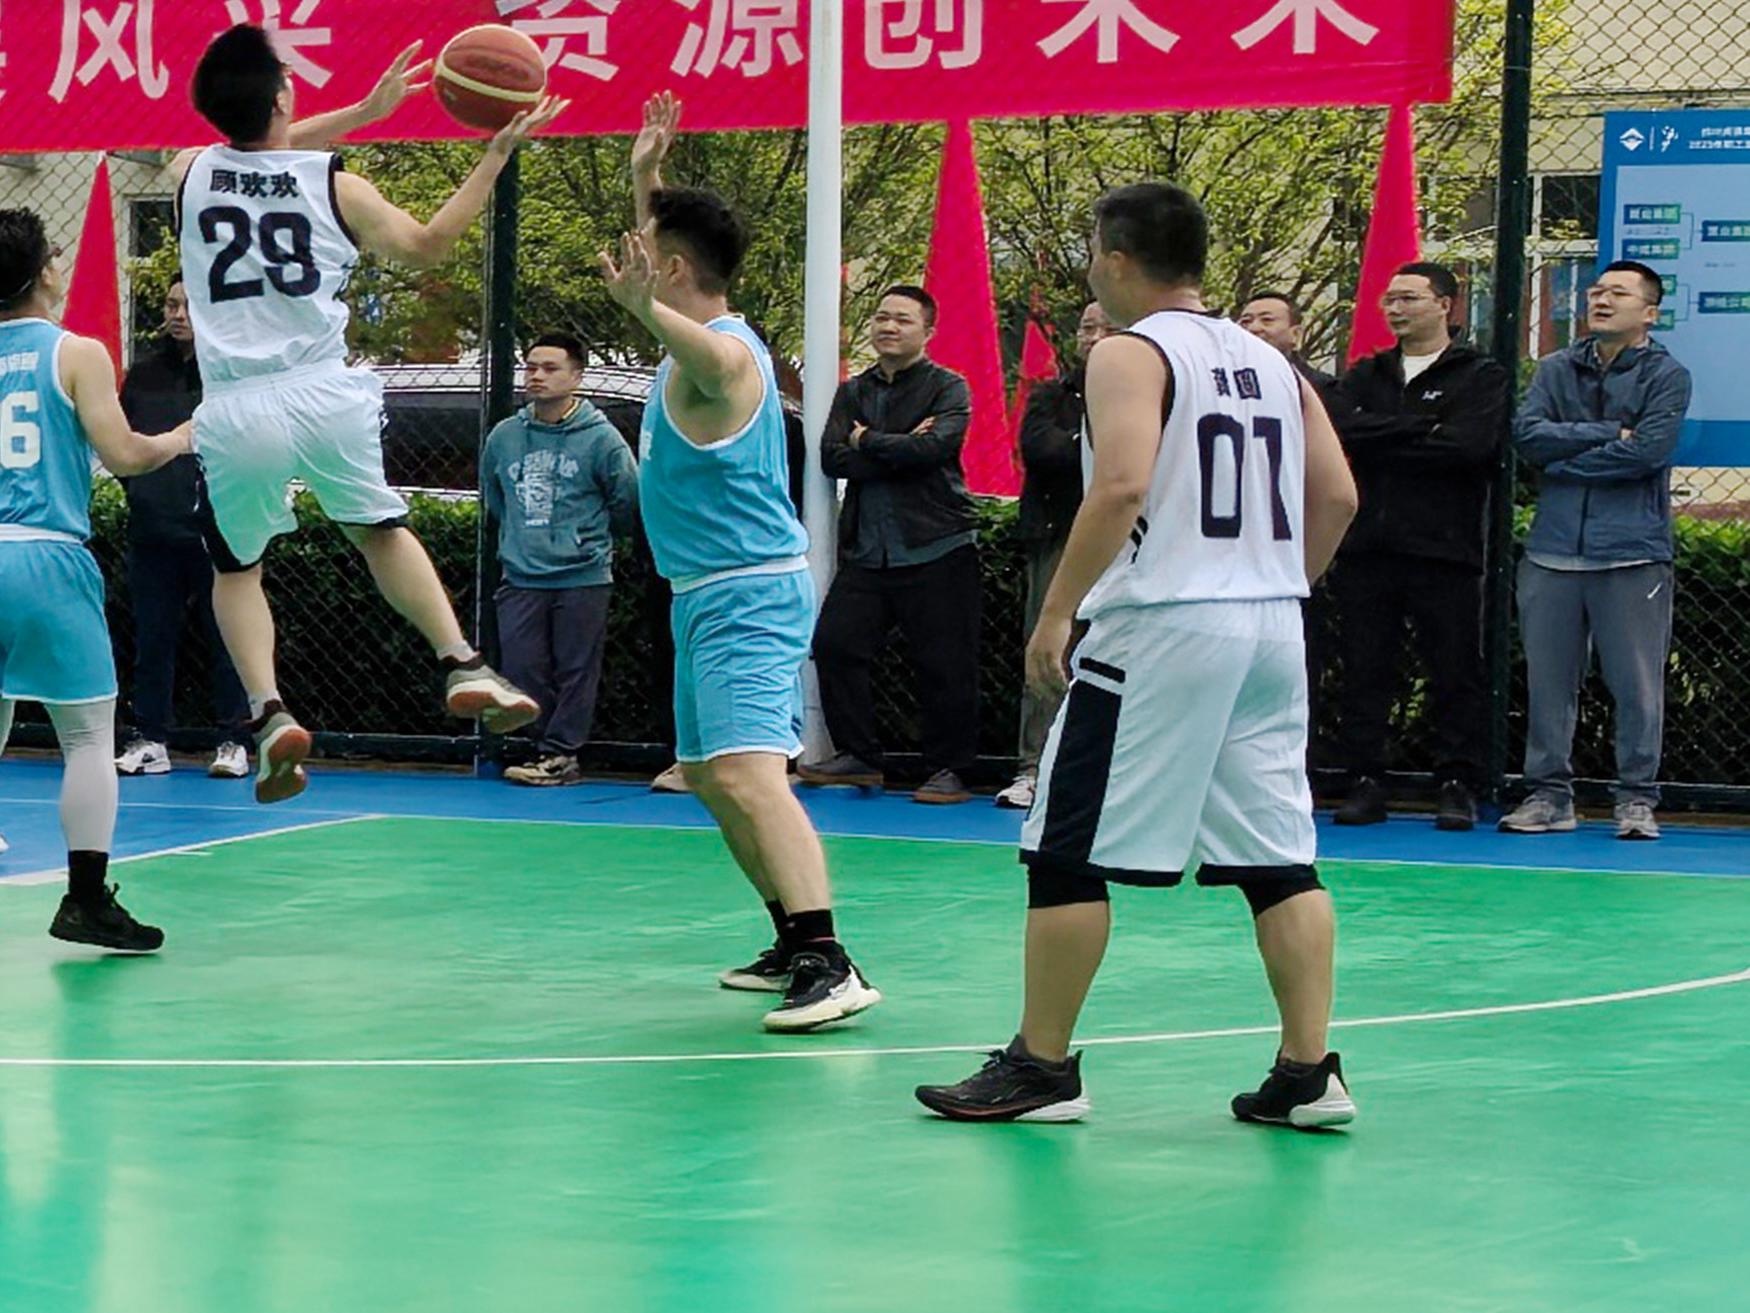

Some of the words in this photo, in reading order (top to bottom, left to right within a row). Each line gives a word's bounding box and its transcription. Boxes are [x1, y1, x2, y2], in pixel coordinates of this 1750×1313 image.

[210, 169, 300, 199] 顾欢欢
[198, 205, 321, 304] 29
[1197, 412, 1293, 541] 01
